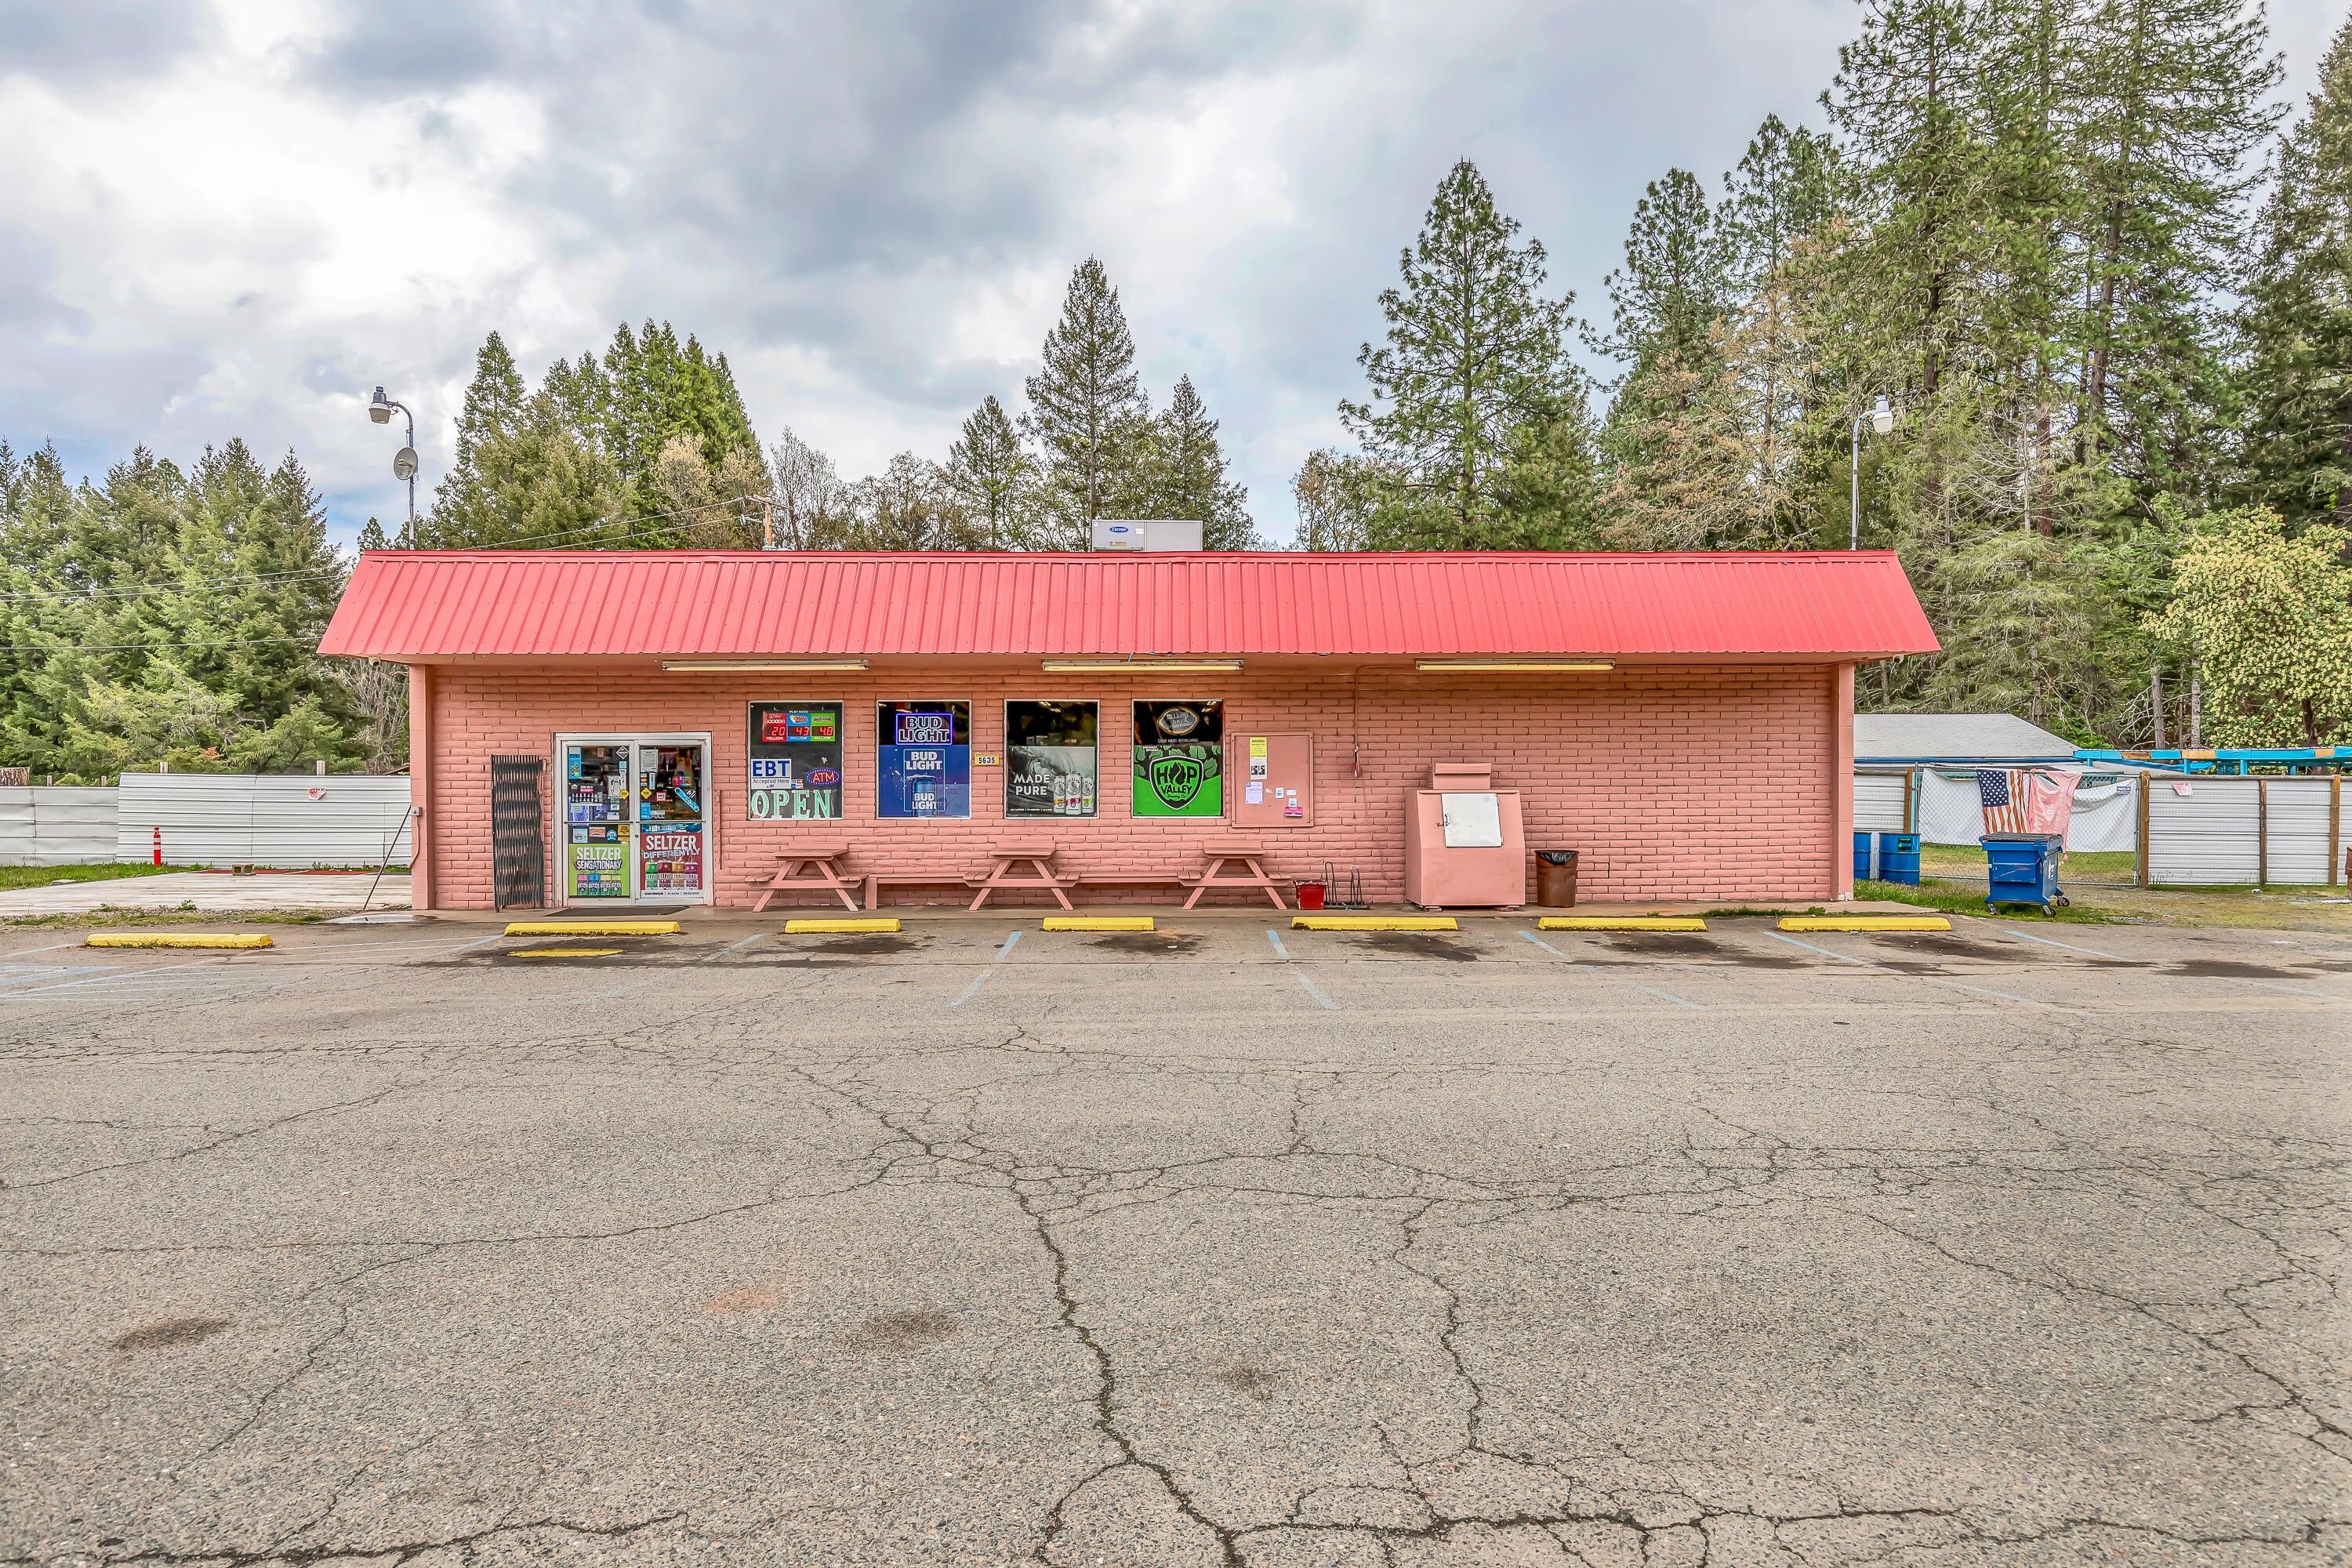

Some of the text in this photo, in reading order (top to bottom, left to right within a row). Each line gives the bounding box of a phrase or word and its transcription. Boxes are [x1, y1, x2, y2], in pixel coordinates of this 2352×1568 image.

[906, 716, 942, 729] BUD
[771, 726, 786, 736] 20
[796, 726, 810, 736] 43
[910, 751, 938, 761] BUD
[752, 760, 790, 777] EBT
[812, 772, 835, 782] ATM
[1014, 774, 1051, 783] MADE
[1156, 762, 1198, 786] HOP
[1015, 786, 1047, 796] PURE
[1160, 784, 1192, 795] VALLEY
[913, 793, 935, 801] BUD
[751, 789, 832, 819] OPEN
[912, 800, 937, 810] LIGHT
[646, 835, 697, 850] SELTZER
[576, 847, 622, 860] SELTZER
[643, 848, 701, 859] DIFFERENTLY
